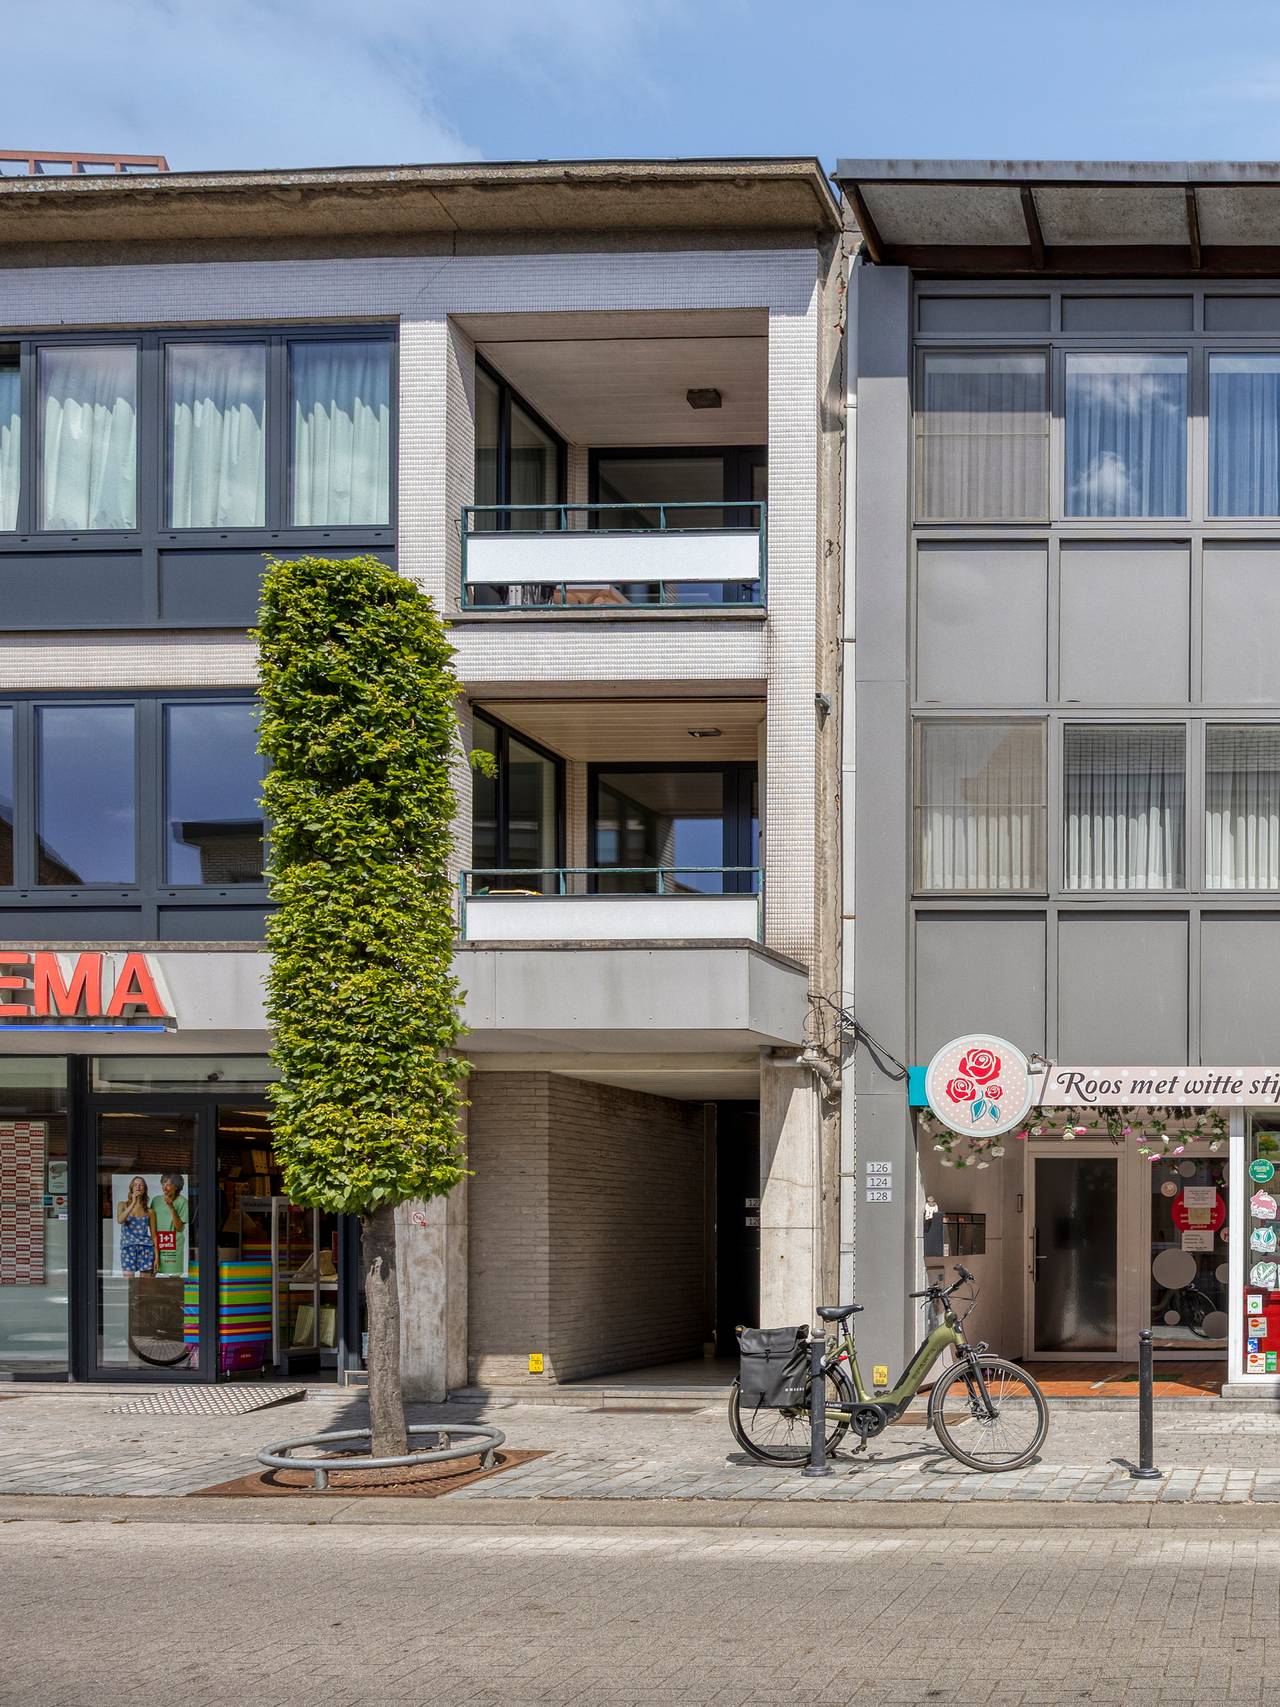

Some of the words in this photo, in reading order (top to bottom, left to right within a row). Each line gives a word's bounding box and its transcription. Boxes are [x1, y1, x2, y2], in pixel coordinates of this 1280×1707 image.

[1056, 1072, 1122, 1103] Roos
[1130, 1075, 1182, 1095] met
[1184, 1073, 1243, 1095] witte
[870, 1163, 888, 1173] 126
[870, 1178, 888, 1187] 124
[870, 1192, 888, 1201] 128
[159, 1234, 174, 1243] 1+1
